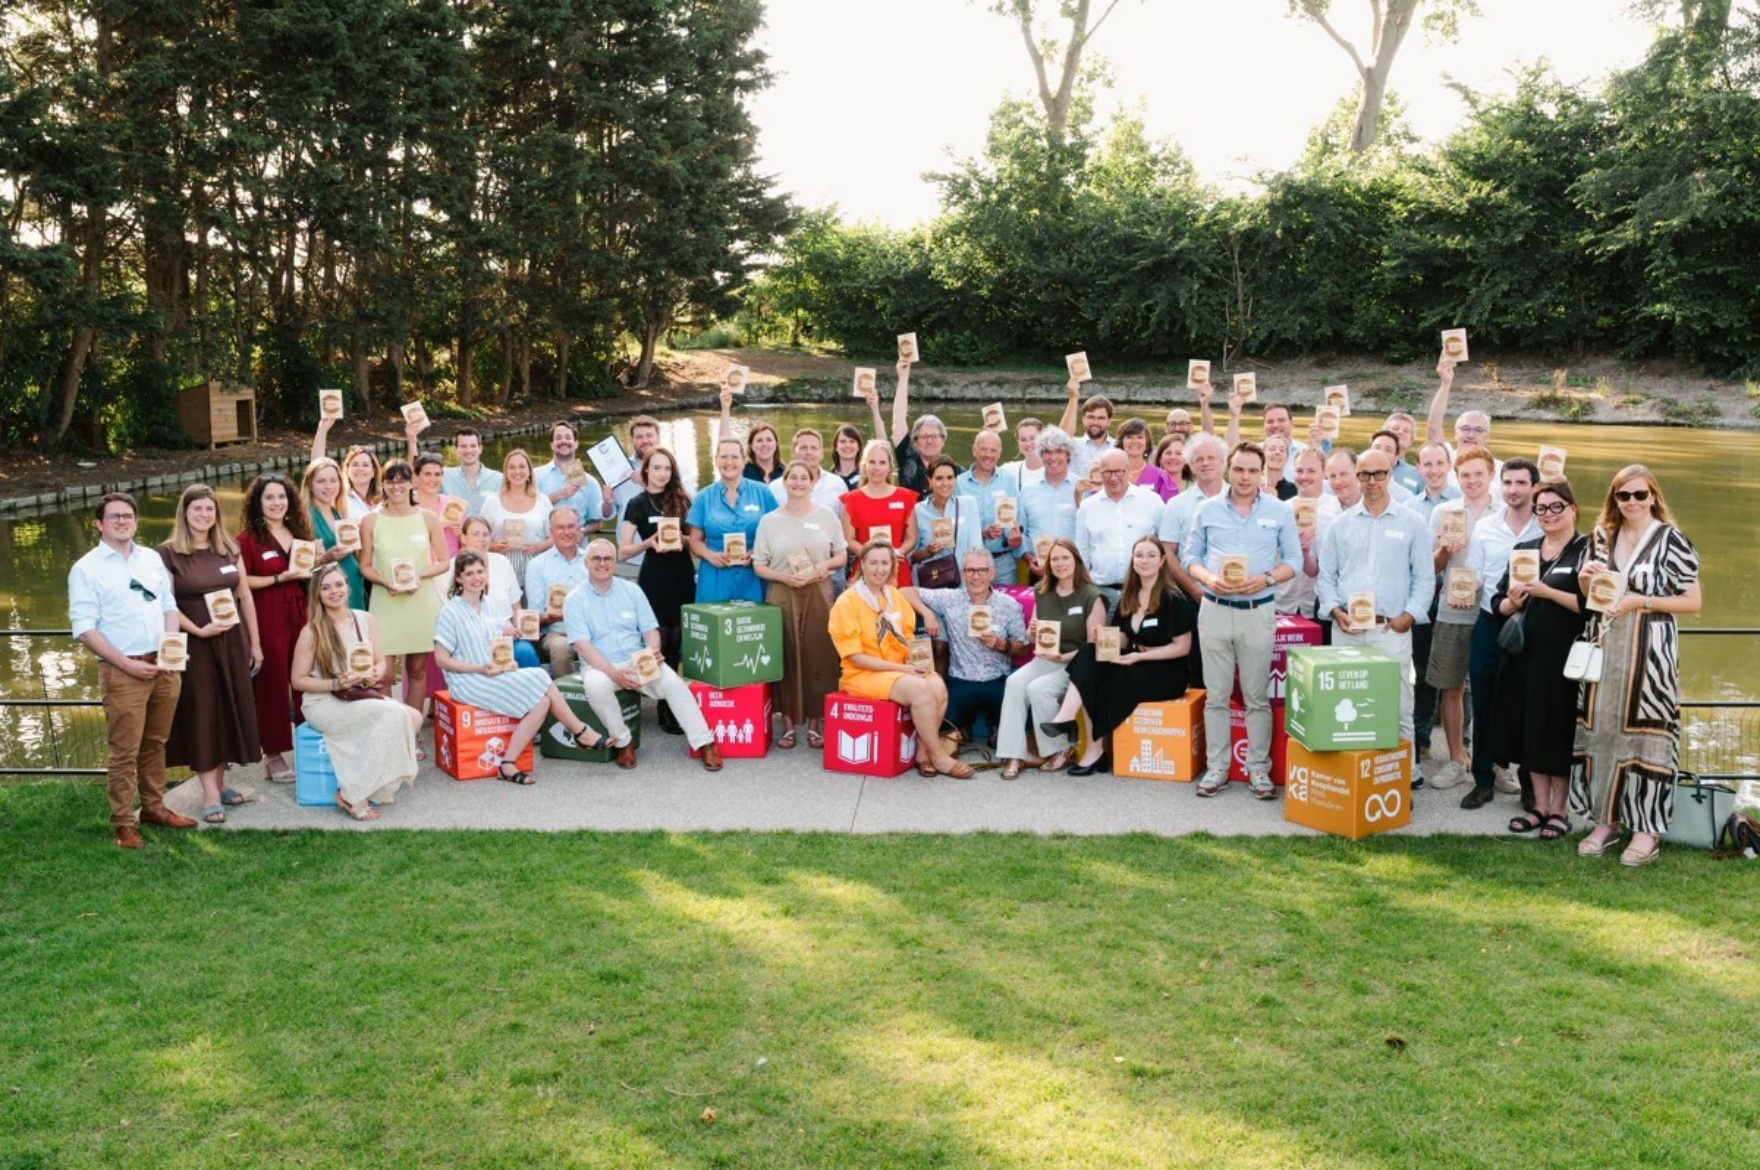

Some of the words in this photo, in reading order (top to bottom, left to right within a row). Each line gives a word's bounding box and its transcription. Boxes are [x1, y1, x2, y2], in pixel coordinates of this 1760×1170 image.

[725, 618, 732, 635] 3
[1318, 671, 1334, 690] 15
[1339, 670, 1359, 680] LEVEN
[830, 702, 839, 719] 4
[462, 711, 471, 728] 9
[1361, 758, 1371, 778] 12
